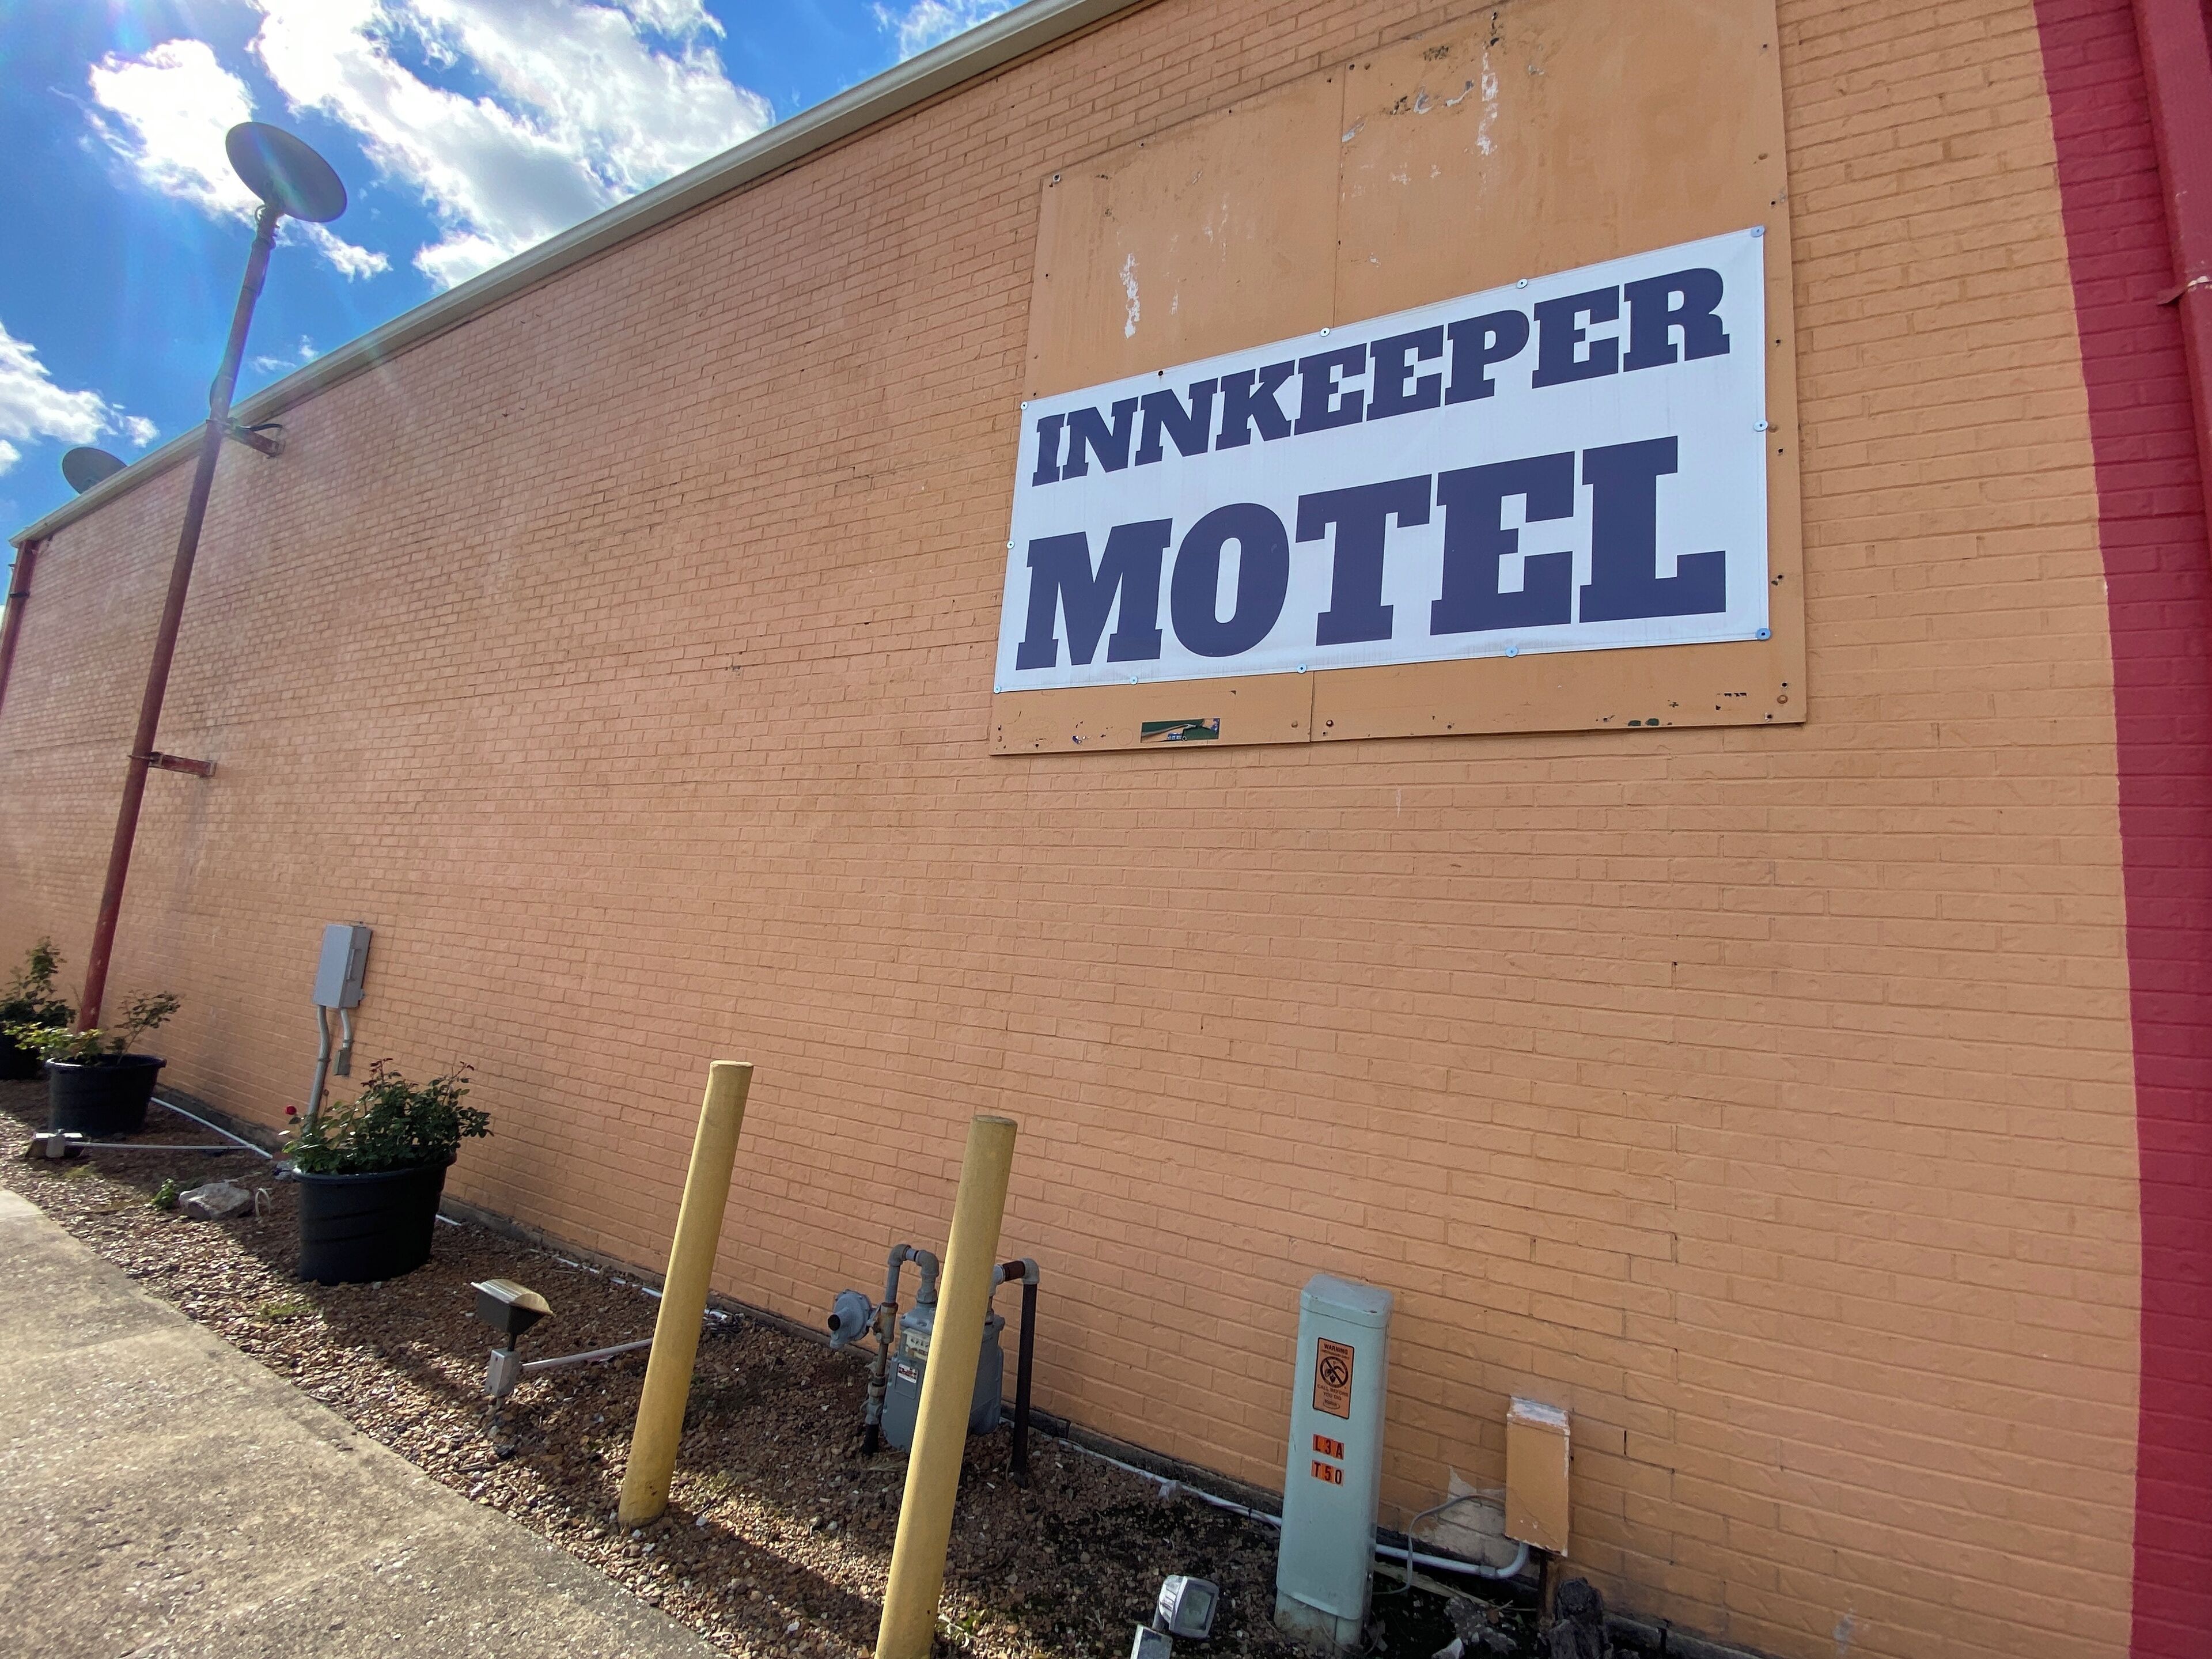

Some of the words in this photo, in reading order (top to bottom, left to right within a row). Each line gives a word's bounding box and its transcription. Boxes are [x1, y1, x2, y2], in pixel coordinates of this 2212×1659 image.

[1032, 268, 1730, 487] INNKEEPER
[1015, 435, 1726, 671] MOTEL
[1324, 1343, 1349, 1355] WARNING
[1315, 1435, 1343, 1460] L3A
[1313, 1461, 1343, 1484] T50
